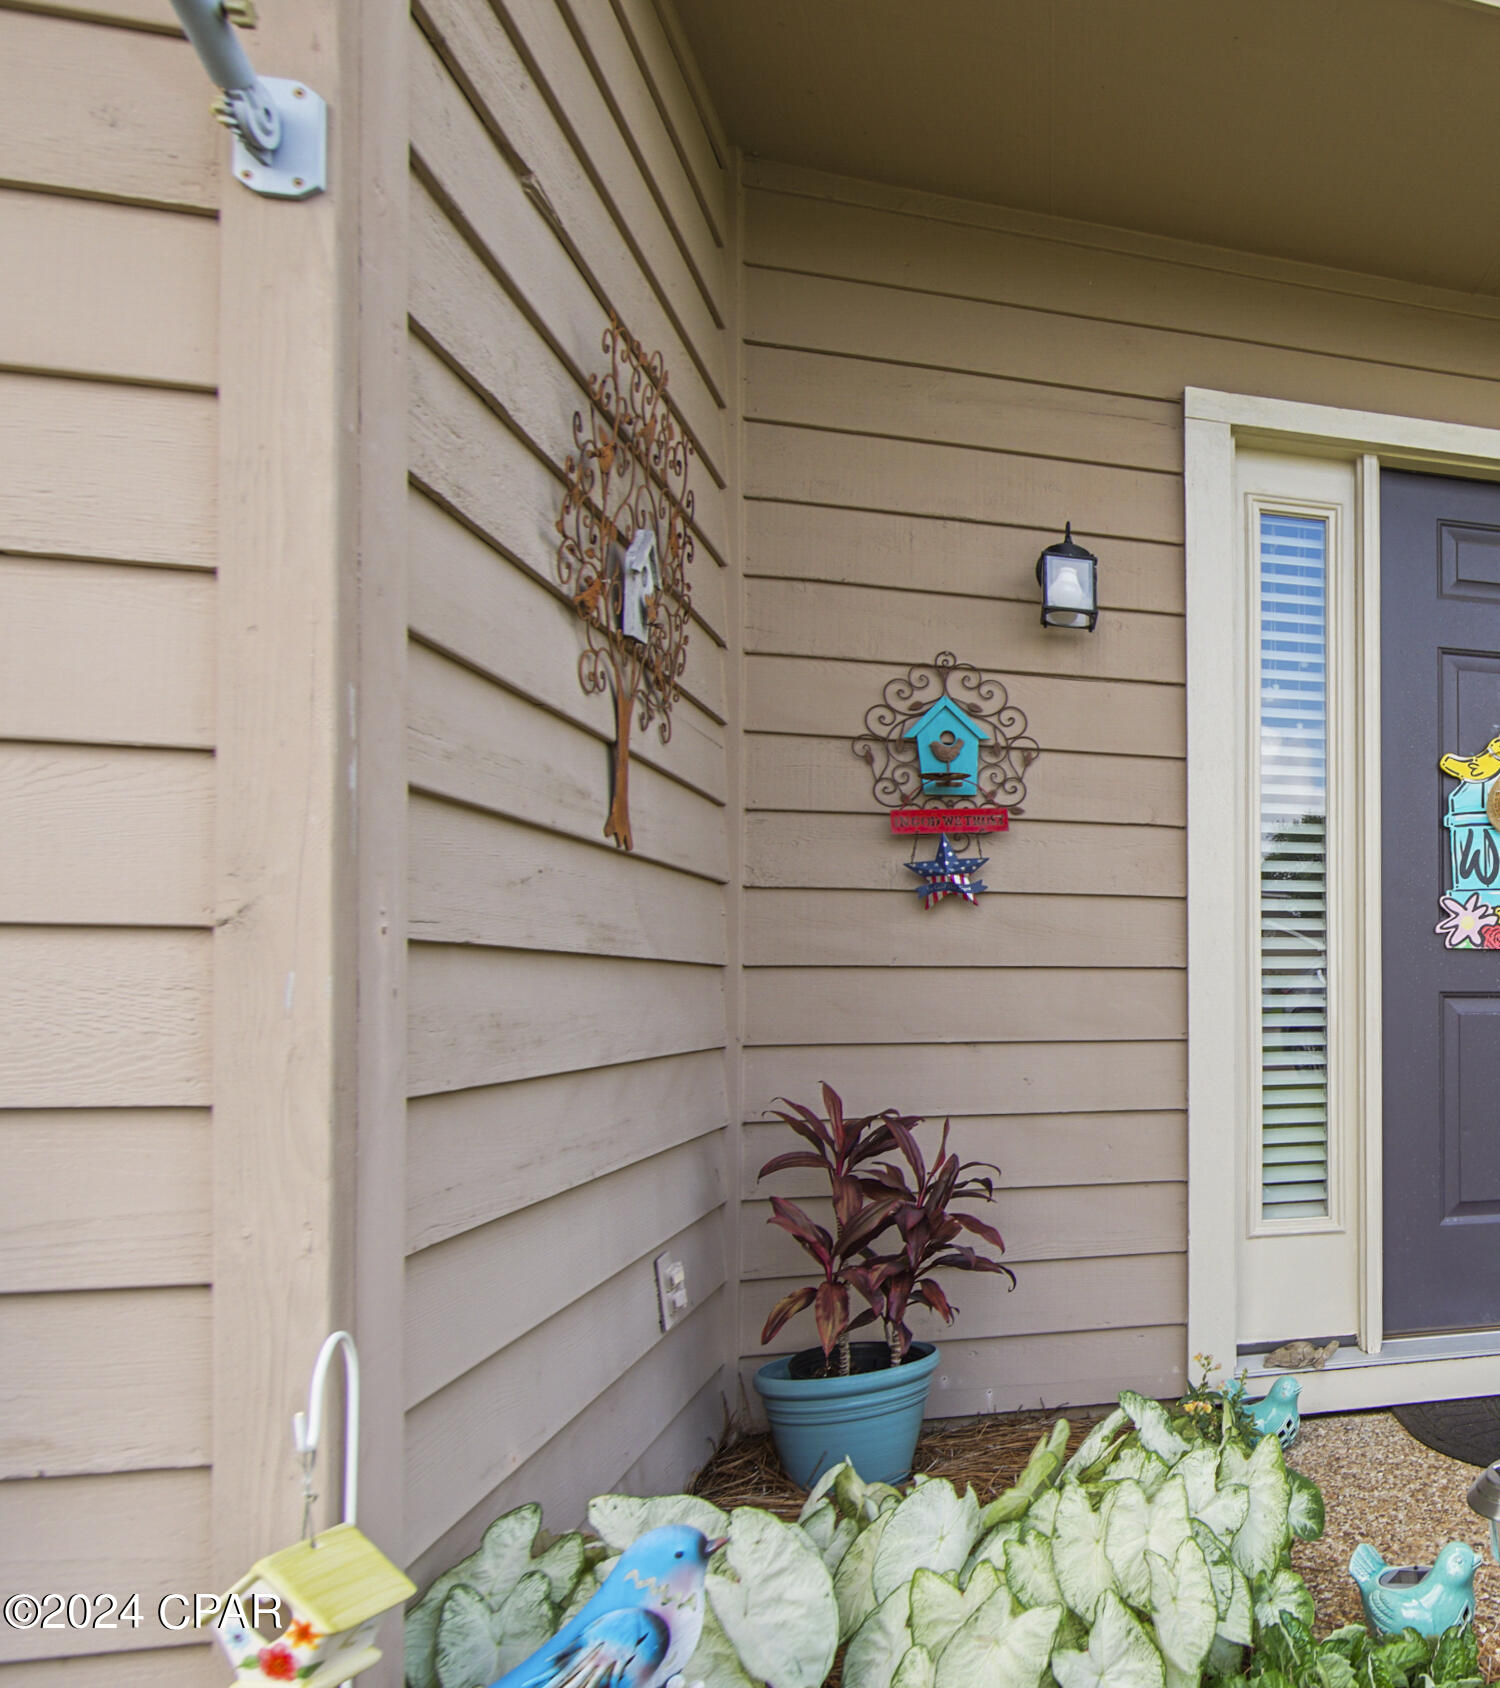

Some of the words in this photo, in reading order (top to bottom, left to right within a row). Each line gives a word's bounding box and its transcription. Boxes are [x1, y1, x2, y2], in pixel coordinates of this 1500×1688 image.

[911, 815, 940, 827] GOD
[942, 815, 961, 826] WE
[963, 814, 1005, 826] TRUST
